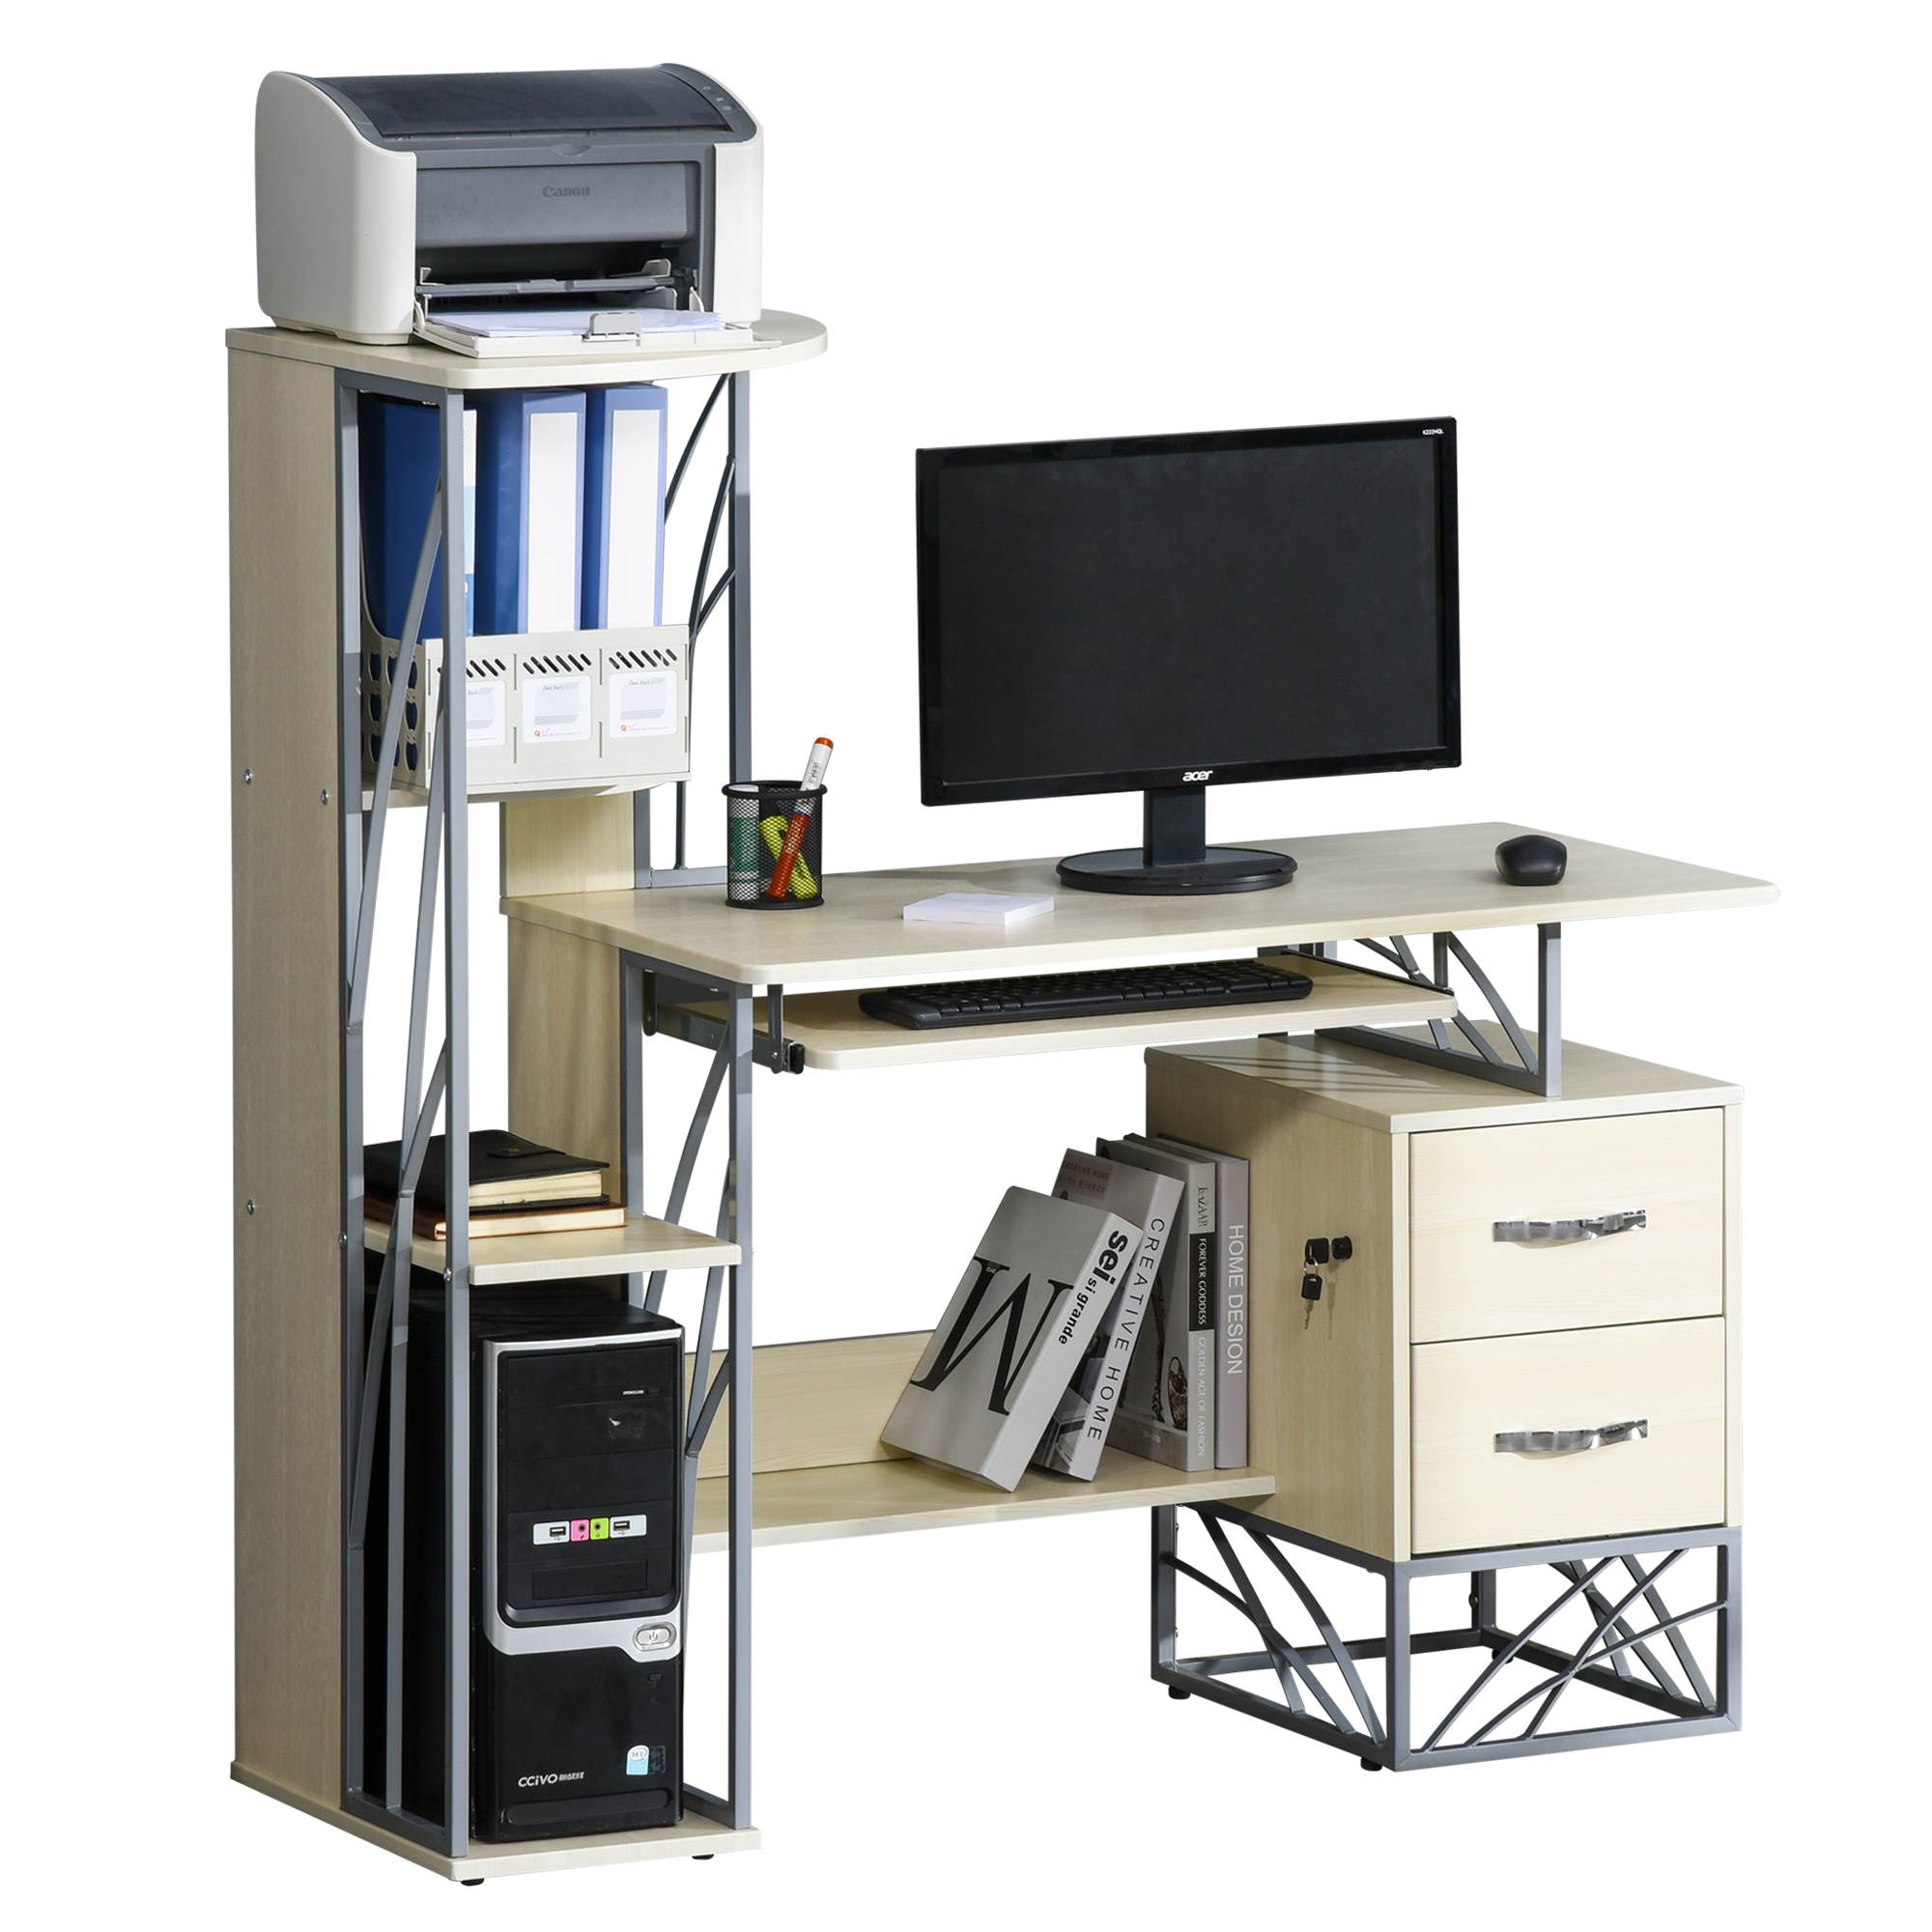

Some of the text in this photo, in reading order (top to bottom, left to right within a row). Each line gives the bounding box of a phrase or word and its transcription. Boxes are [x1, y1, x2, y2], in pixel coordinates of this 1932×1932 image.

[542, 185, 591, 198] Canon
[1182, 770, 1213, 781] acer
[1093, 1230, 1128, 1285] sei
[1198, 1237, 1208, 1325] FOREVER GODDESS
[1059, 1293, 1089, 1345] grande
[1088, 1218, 1165, 1441] CREATIVE HOME
[1227, 1225, 1244, 1374] HOME DESIGN
[1197, 1336, 1207, 1457] GOLDEN AGE OF FASHION
